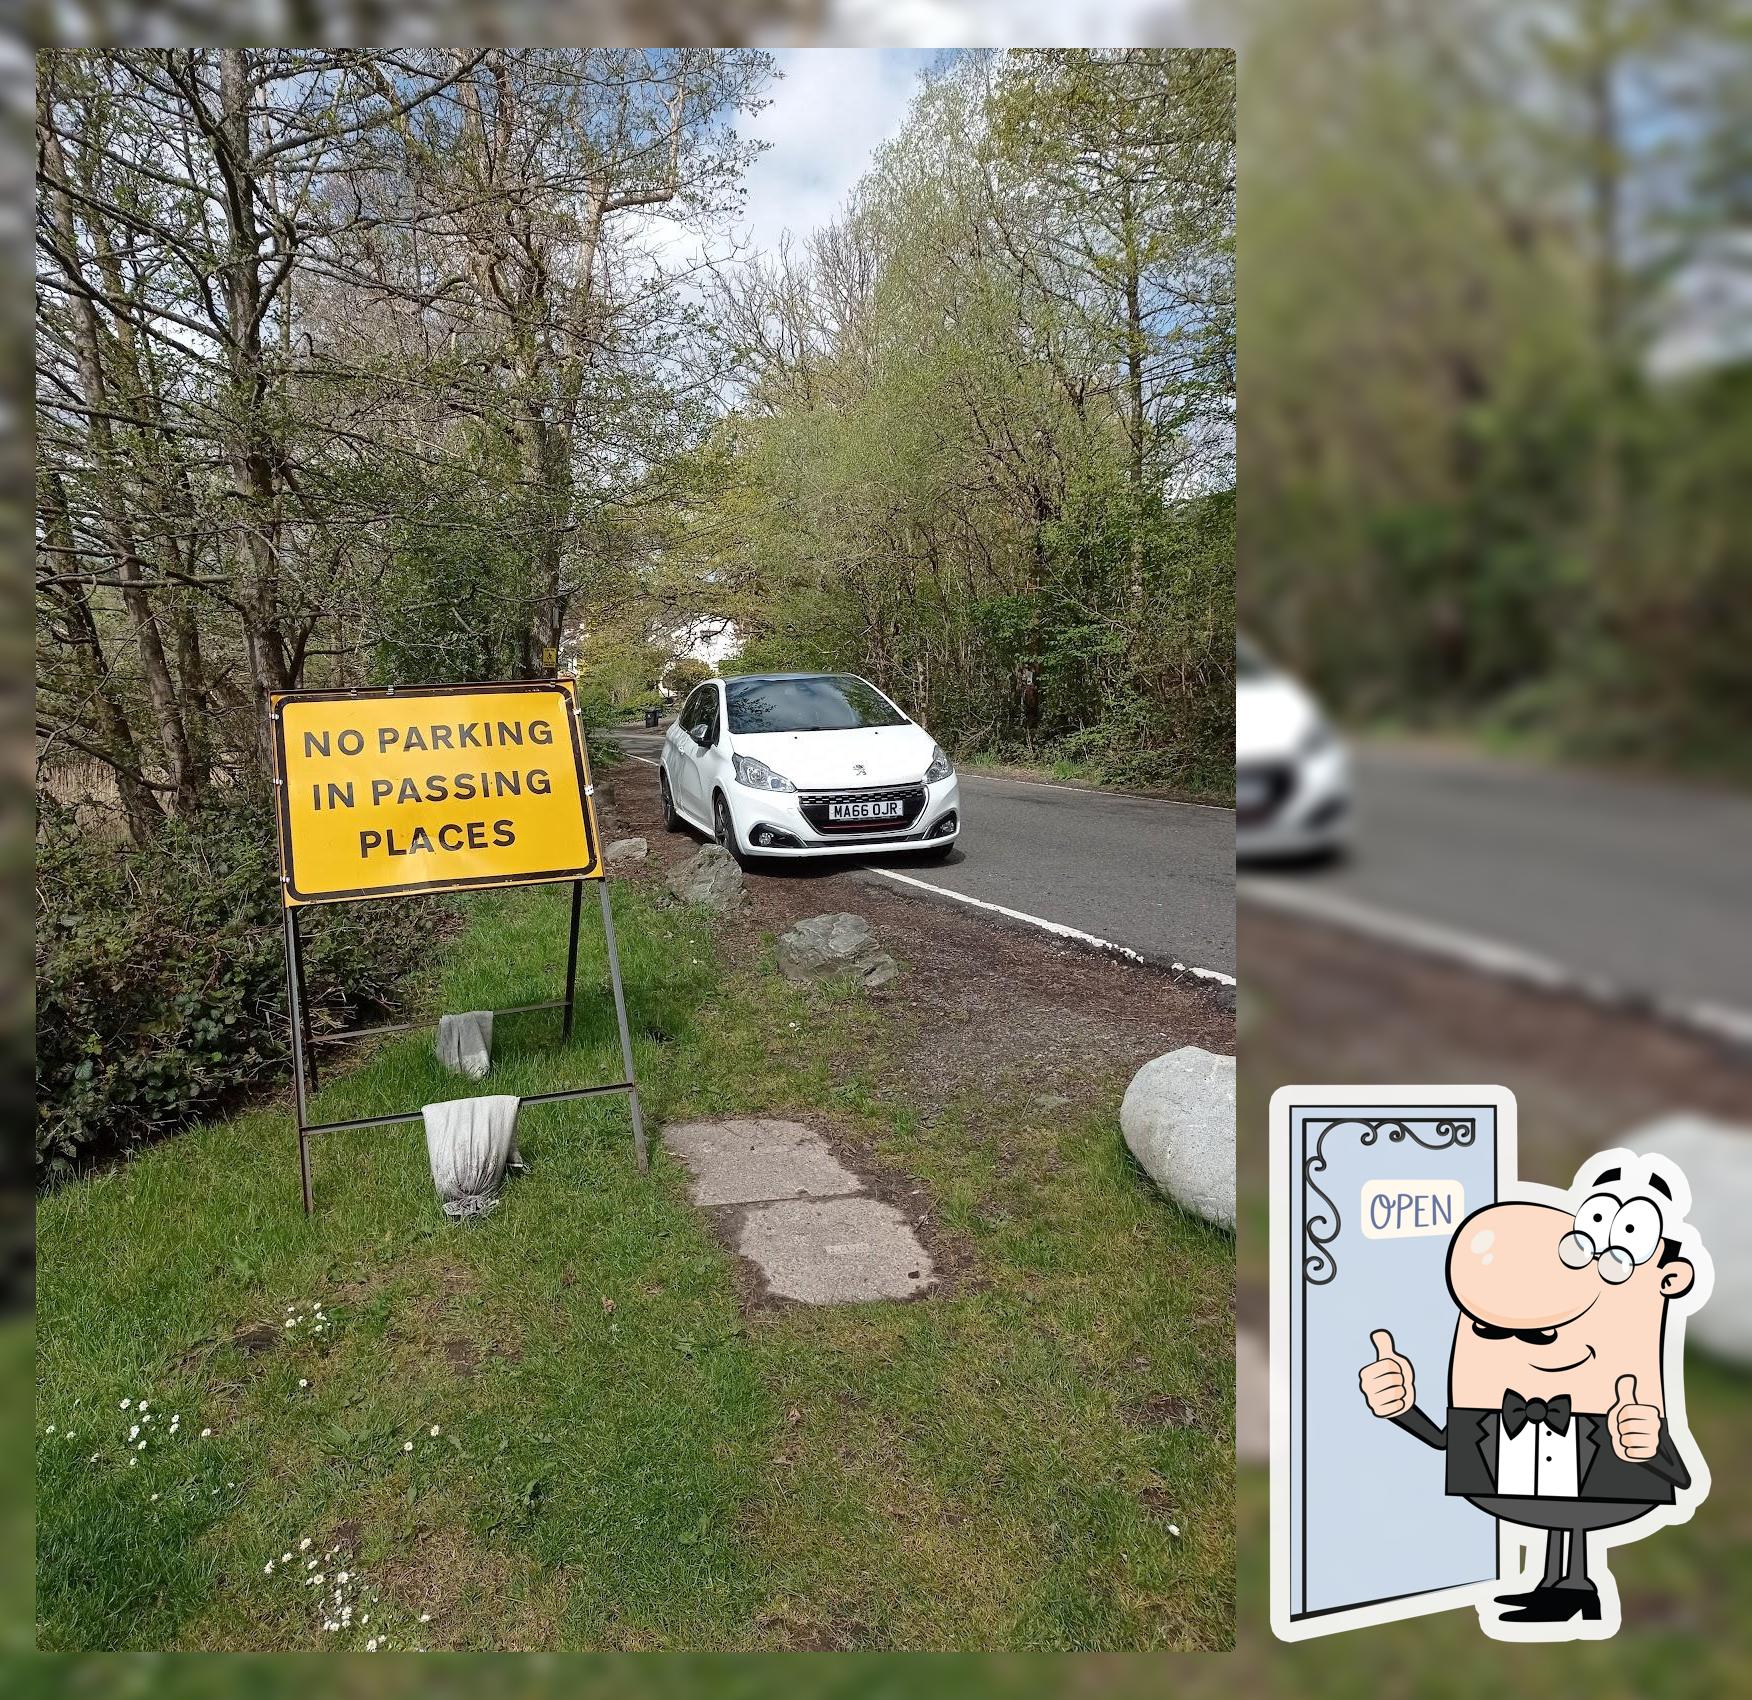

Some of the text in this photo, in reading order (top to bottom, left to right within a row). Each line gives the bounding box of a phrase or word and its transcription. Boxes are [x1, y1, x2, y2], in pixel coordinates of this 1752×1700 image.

[304, 720, 553, 758] NO PARKING
[312, 769, 552, 811] IN PASSING
[834, 802, 898, 818] MA66 OJR
[359, 819, 516, 859] PLACES
